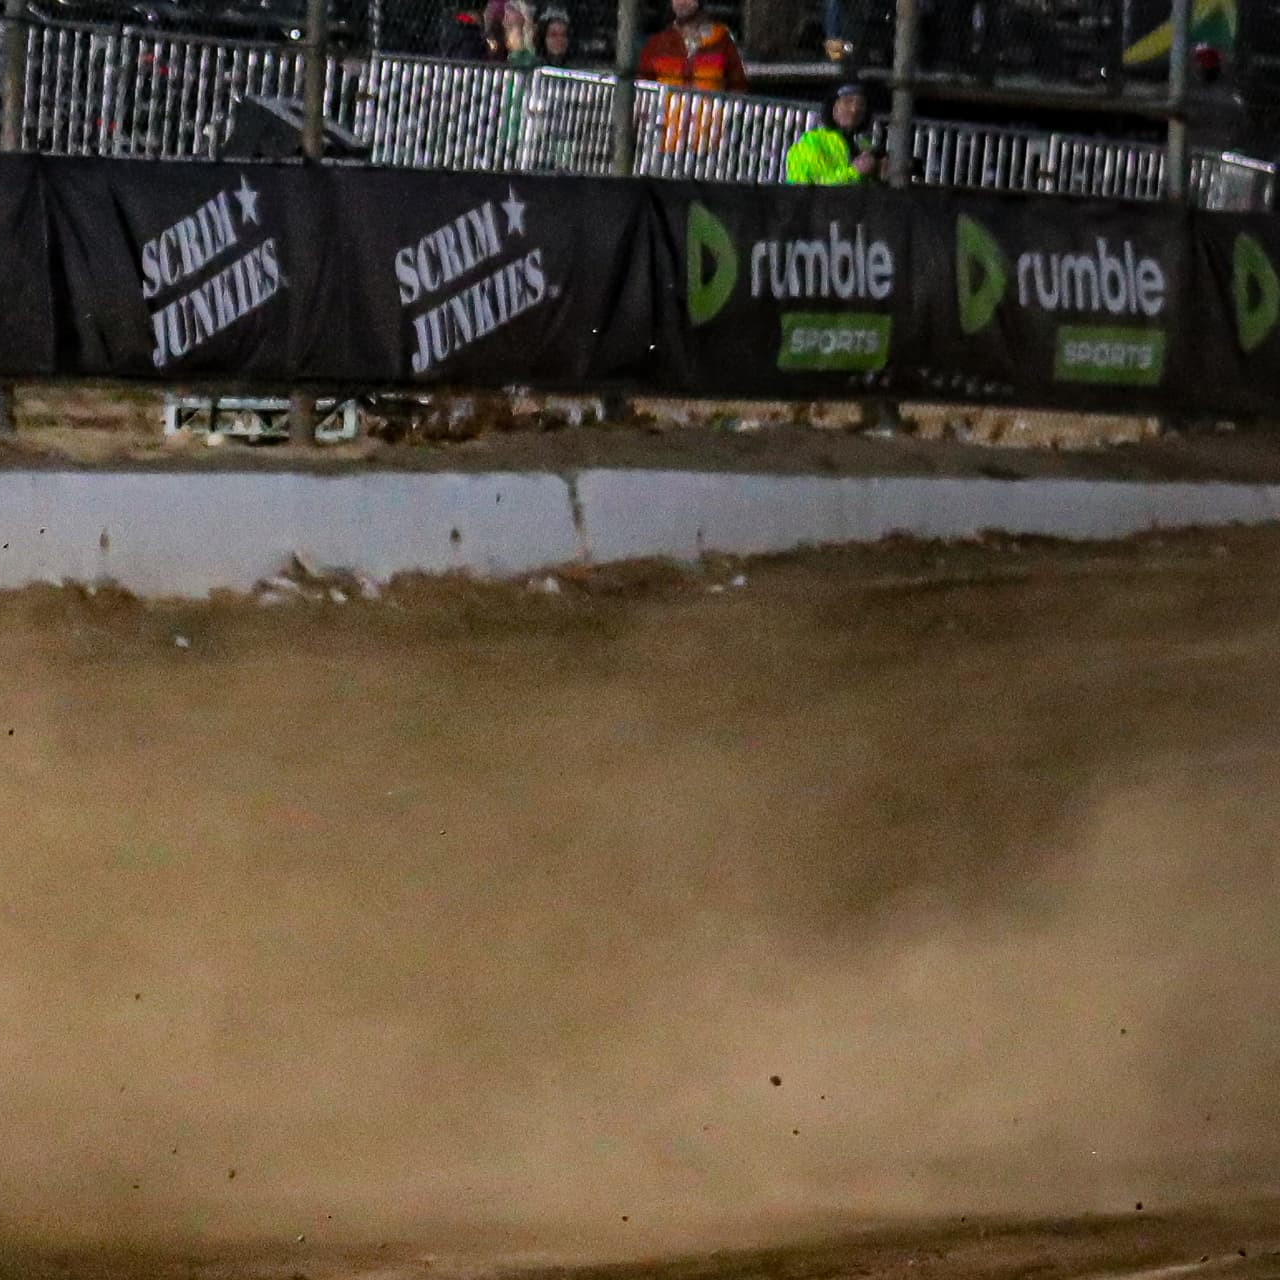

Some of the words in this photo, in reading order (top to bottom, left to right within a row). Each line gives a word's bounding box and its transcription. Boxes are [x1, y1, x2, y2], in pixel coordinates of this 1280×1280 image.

[142, 189, 239, 300] SCRIM
[394, 200, 503, 304] SCRIM
[750, 220, 896, 300] rumble
[1016, 236, 1166, 317] rumble
[151, 236, 282, 369] JUNKIES
[411, 248, 546, 374] JUNKIES
[789, 328, 878, 354] SPORTS
[1063, 340, 1153, 367] SPORTS
